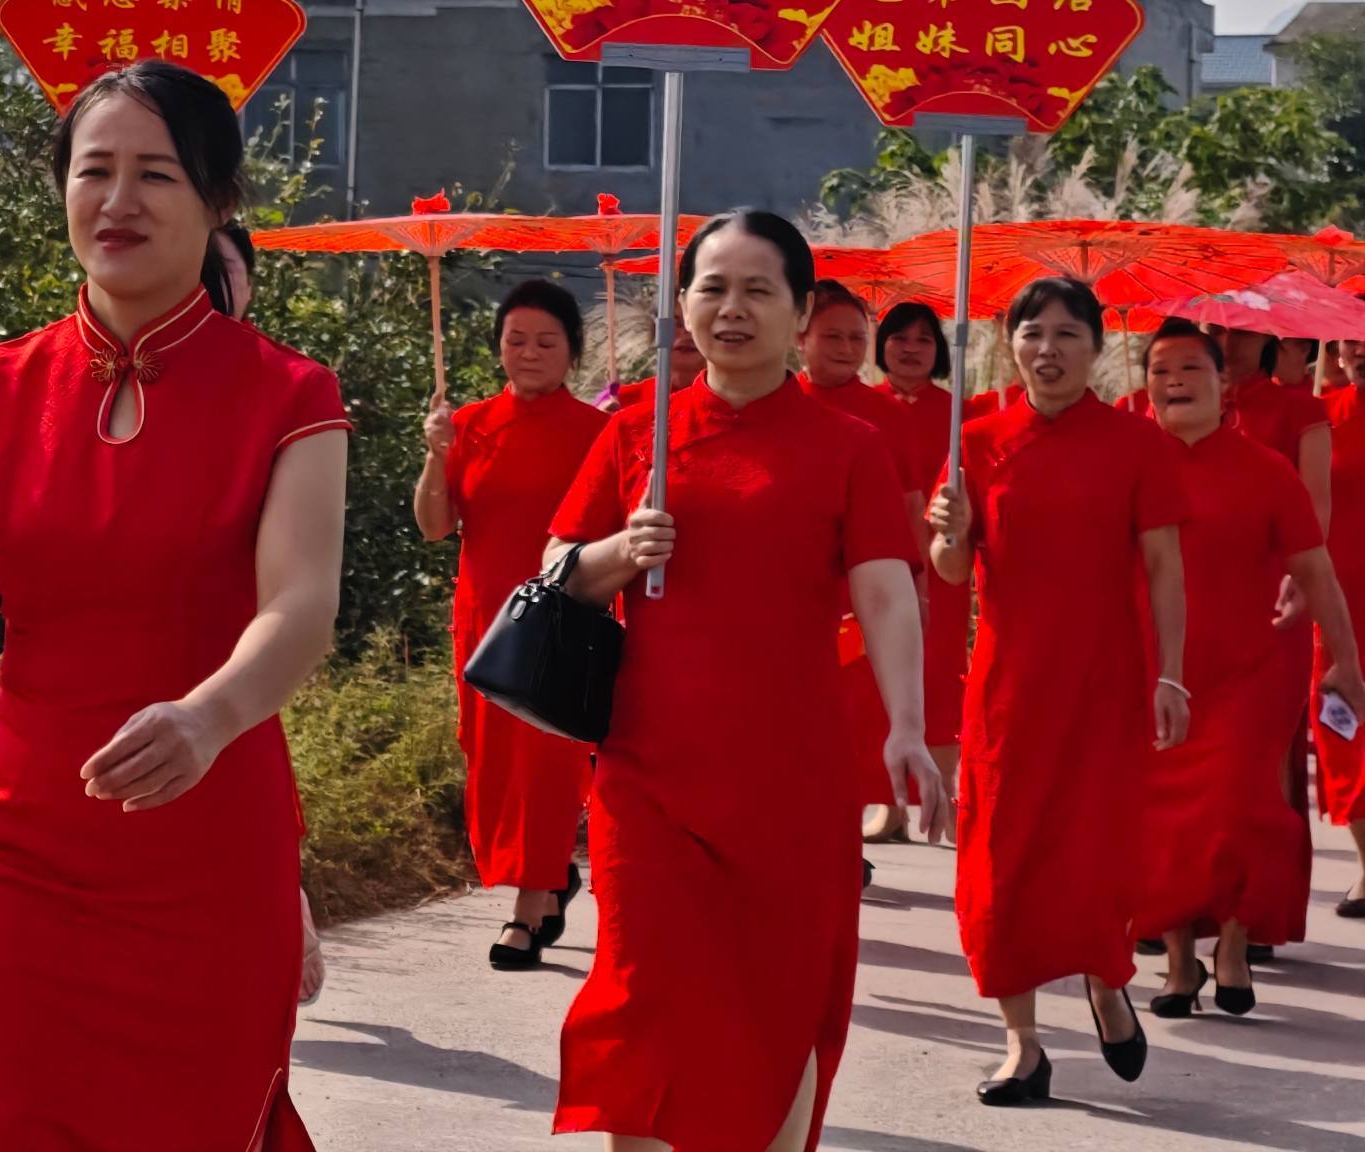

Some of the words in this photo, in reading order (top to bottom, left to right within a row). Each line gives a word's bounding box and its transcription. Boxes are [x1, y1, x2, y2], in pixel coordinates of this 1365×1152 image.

[43, 22, 241, 63] 幸福相聚
[848, 20, 1098, 63] 姐妹同心
